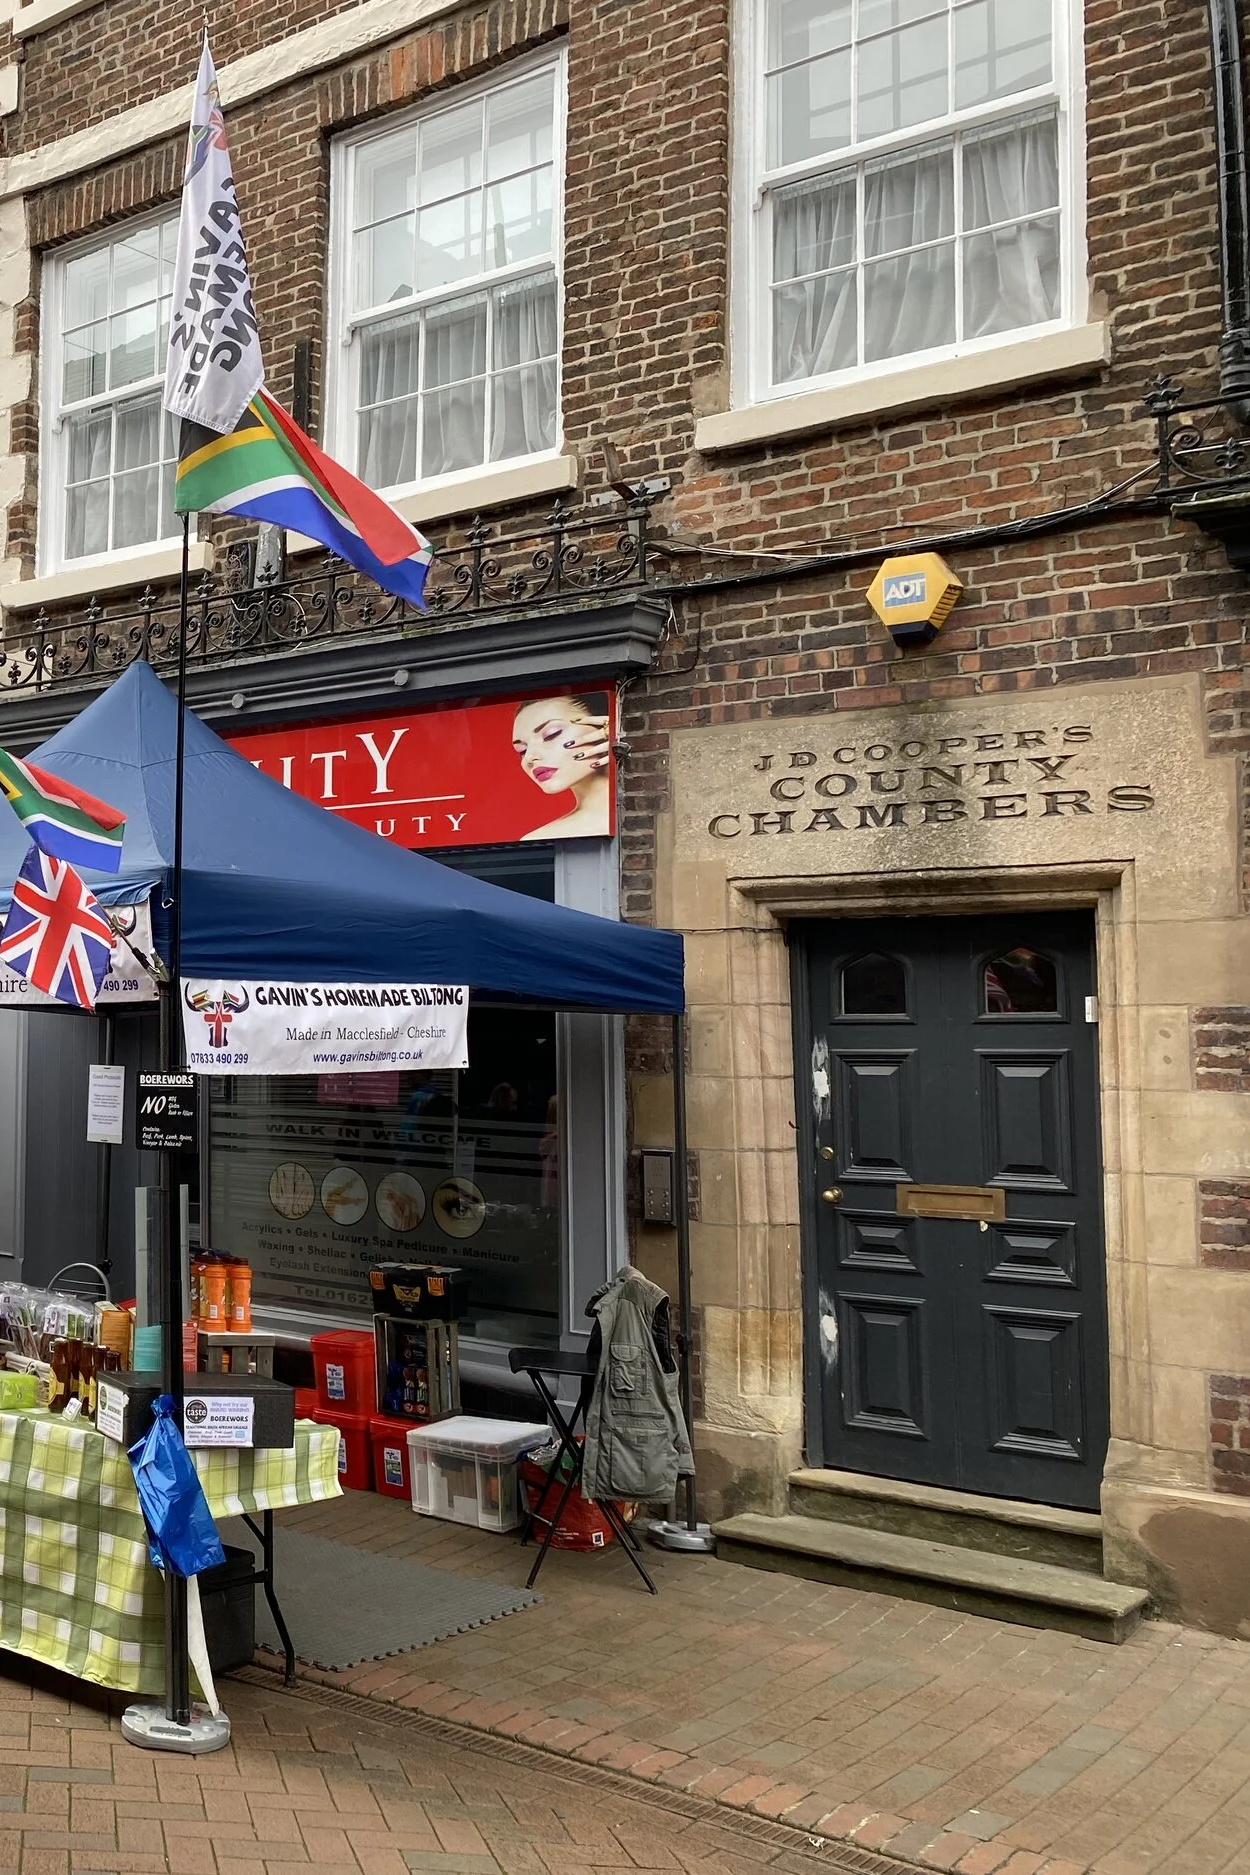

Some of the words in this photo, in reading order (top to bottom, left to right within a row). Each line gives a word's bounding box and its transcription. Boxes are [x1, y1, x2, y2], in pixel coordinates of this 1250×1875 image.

[885, 578, 925, 600] ADT
[754, 754, 775, 771] J
[790, 751, 818, 768] D
[833, 725, 1094, 765] COOPER'S
[770, 754, 1079, 802] COUNTY
[708, 784, 1157, 840] CHAMBERS
[375, 813, 467, 837] UTY
[103, 980, 120, 992] 490
[122, 979, 138, 991] 299
[255, 986, 322, 1008] GAVIN'S
[325, 988, 410, 1008] HOMEMADE
[412, 987, 463, 1006] BILTONG
[286, 1027, 318, 1041] Made
[320, 1027, 332, 1040] in
[336, 1026, 399, 1041] Macclesfield
[407, 1025, 446, 1039] Cheshire
[191, 1053, 214, 1064] 07833
[216, 1053, 232, 1064] 490
[233, 1053, 248, 1064] 299
[313, 1050, 423, 1065] www.gavinsbiltong.co.uk
[140, 1074, 194, 1085] BOEREWORS
[140, 1095, 166, 1114] NO
[266, 1123, 326, 1136] WALK
[338, 1126, 361, 1138] IN
[242, 1221, 283, 1236] Acrylics
[295, 1227, 319, 1239] Gels
[331, 1231, 369, 1247] Luxury
[372, 1235, 393, 1250] Spa
[396, 1238, 448, 1255] Pedicure
[462, 1247, 520, 1264] Manicure
[258, 1239, 295, 1255] Waxing
[307, 1243, 347, 1259] Shellac
[270, 1256, 310, 1272] Eyelash
[313, 1261, 370, 1279] Extension
[187, 1407, 207, 1416] taste
